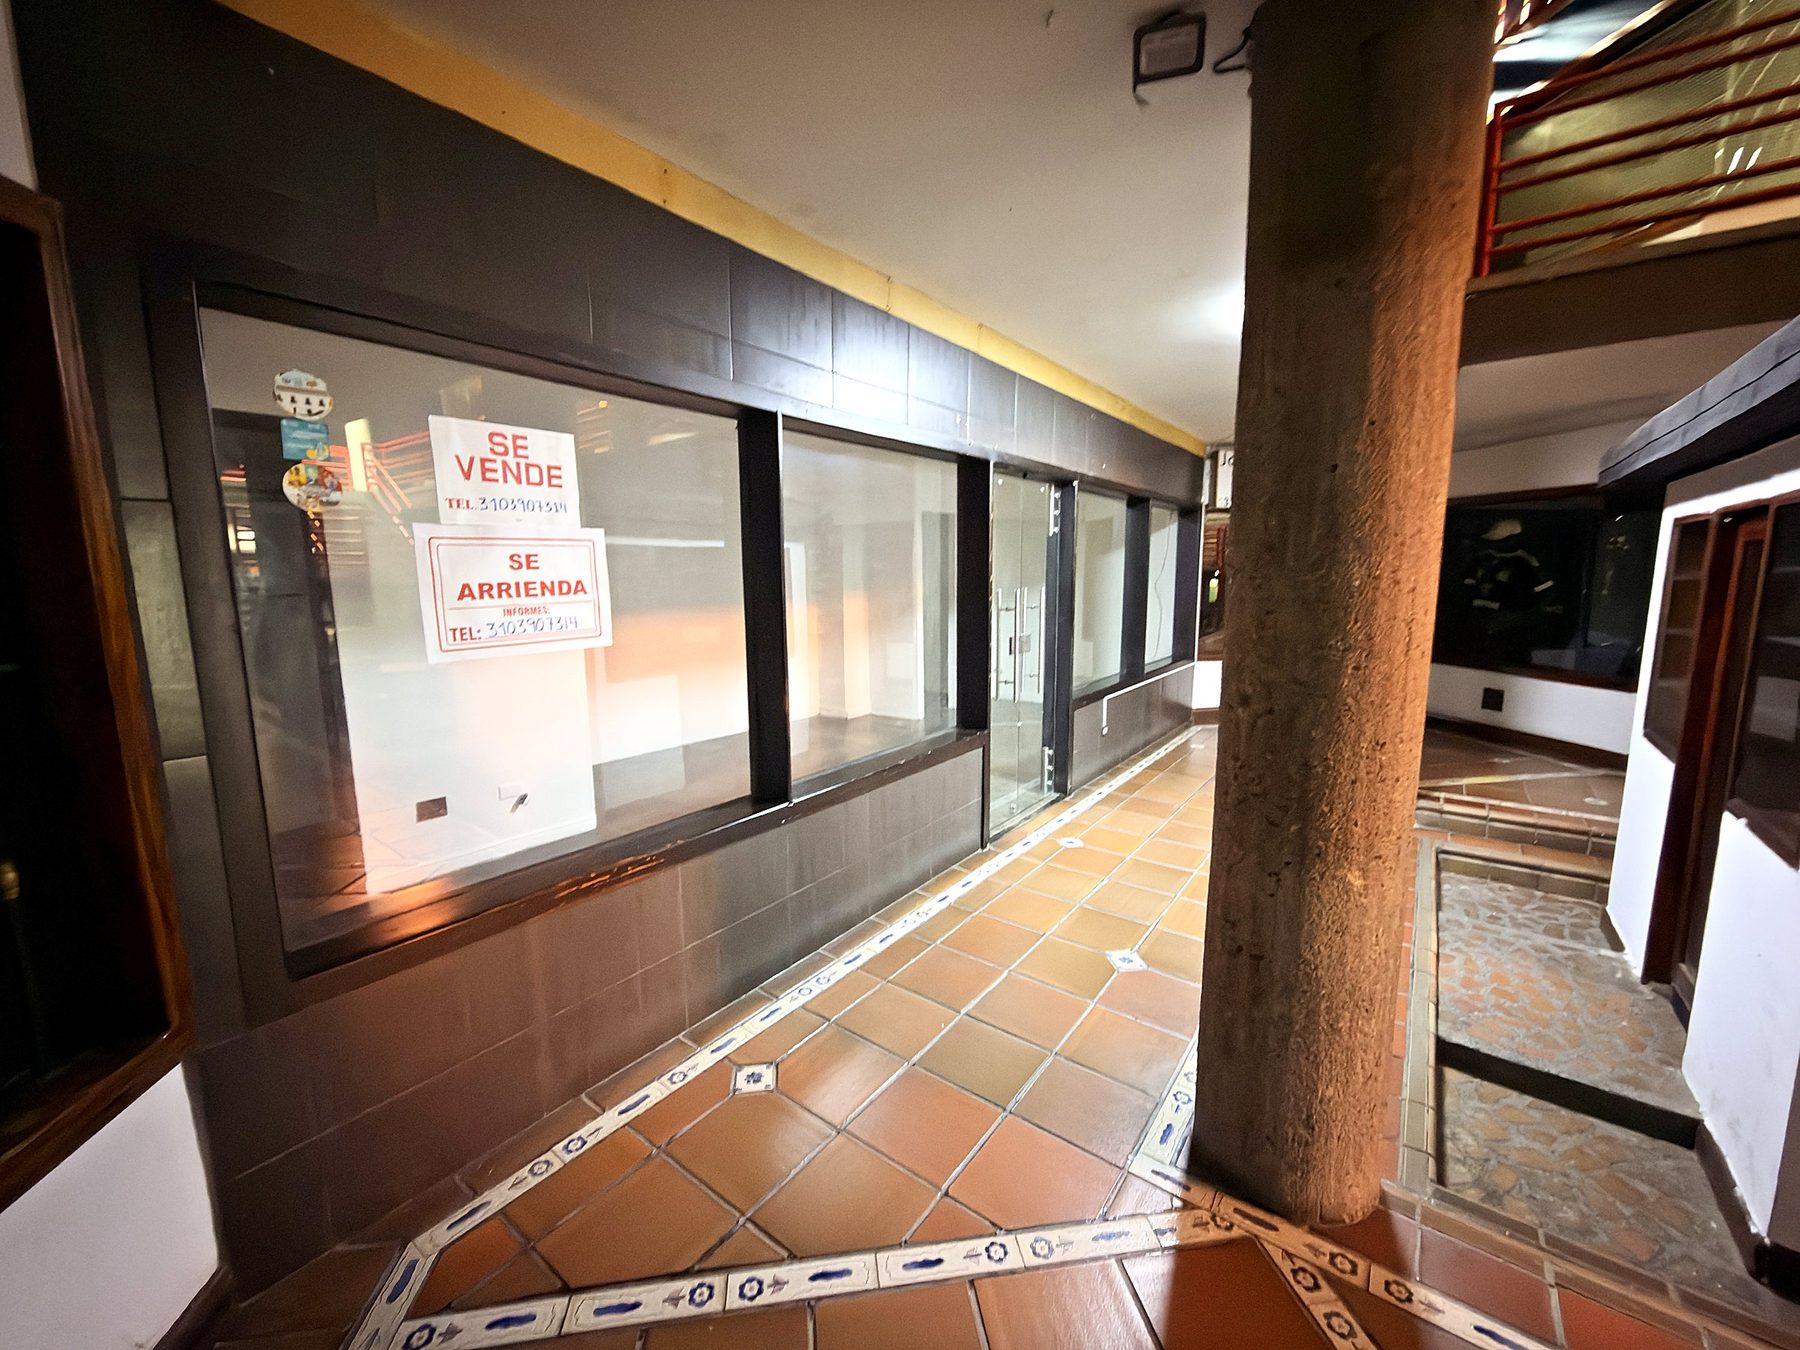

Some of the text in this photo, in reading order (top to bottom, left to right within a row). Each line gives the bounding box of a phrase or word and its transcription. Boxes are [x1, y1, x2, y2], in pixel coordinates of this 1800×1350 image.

[488, 431, 529, 460] SE
[454, 454, 563, 488] VENDE
[479, 496, 568, 513] 3103907314
[508, 553, 540, 571] SE
[456, 579, 588, 602] ARRIENDA
[449, 615, 579, 643] TEL: 3103907314
